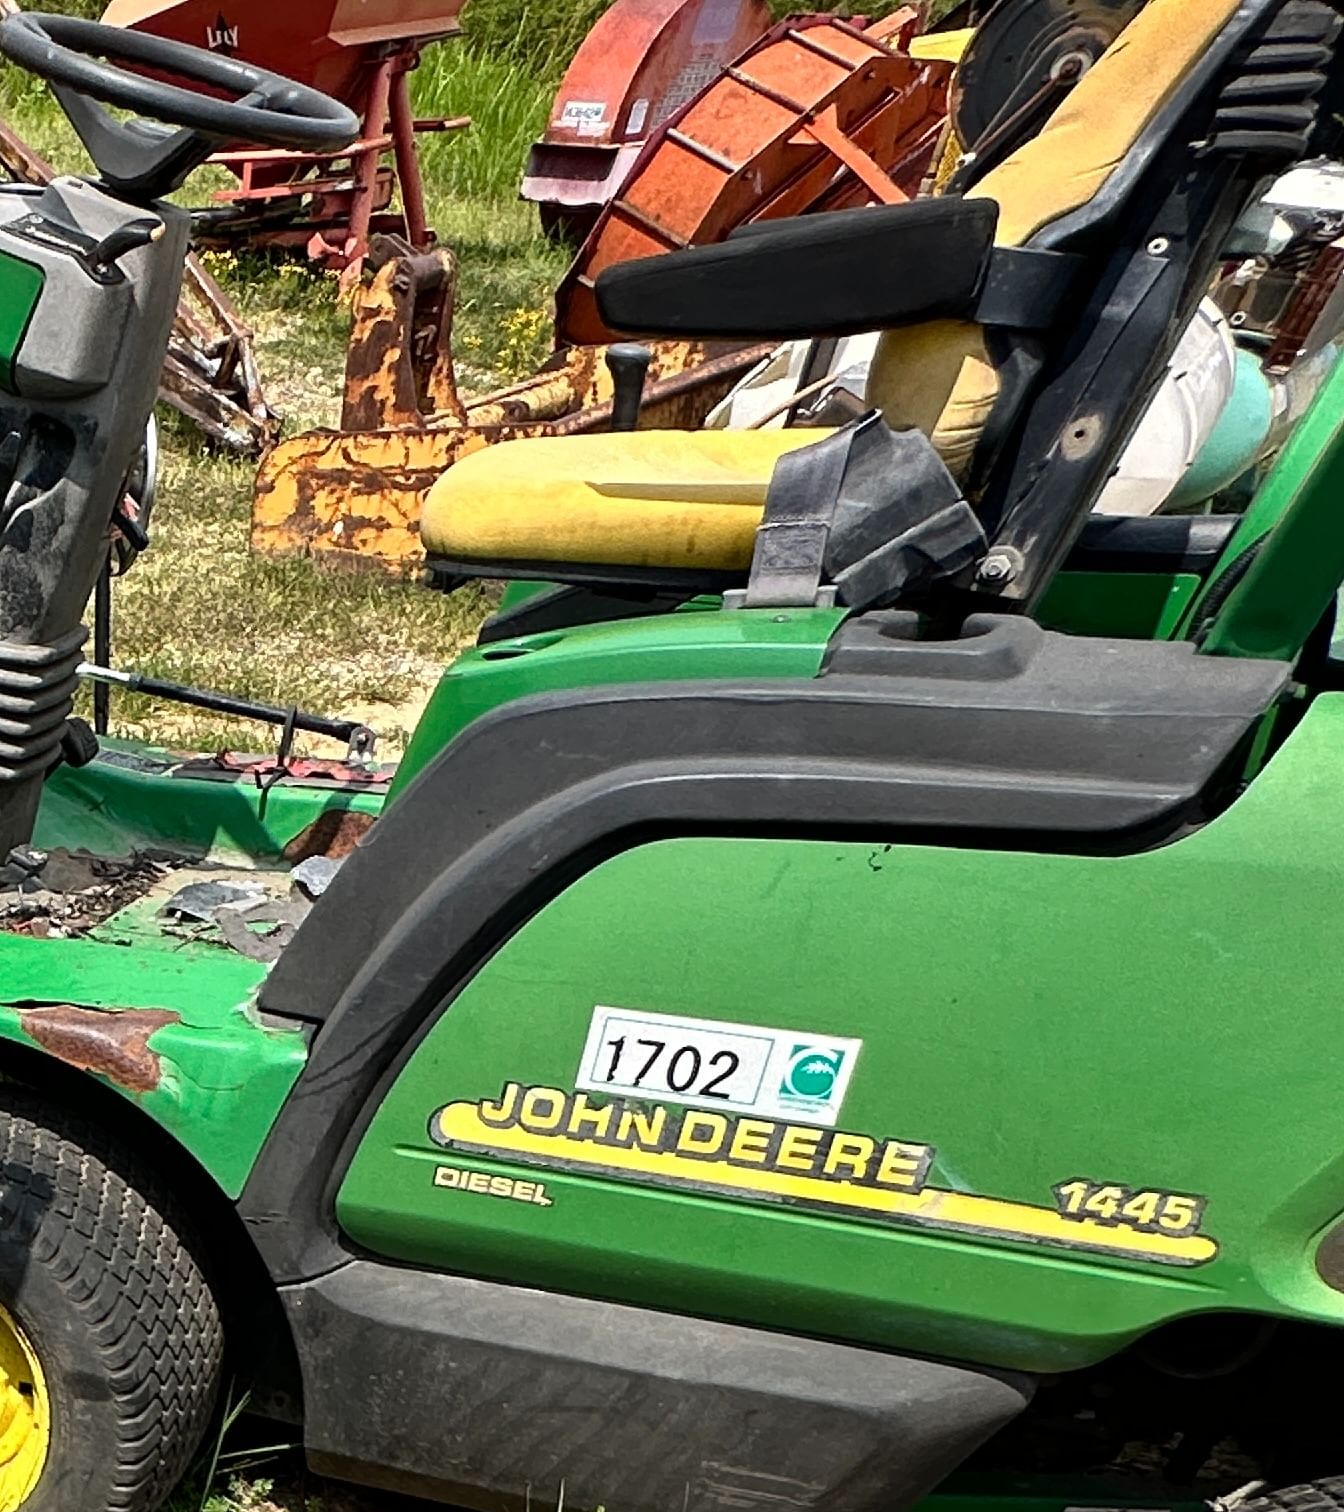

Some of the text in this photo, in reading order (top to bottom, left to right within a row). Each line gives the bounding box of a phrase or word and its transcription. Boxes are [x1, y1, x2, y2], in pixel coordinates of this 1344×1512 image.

[606, 1034, 741, 1100] 1702
[480, 1083, 929, 1188] JOHN DEERE
[433, 1165, 554, 1206] DIESEL
[1056, 1180, 1198, 1231] 1445
